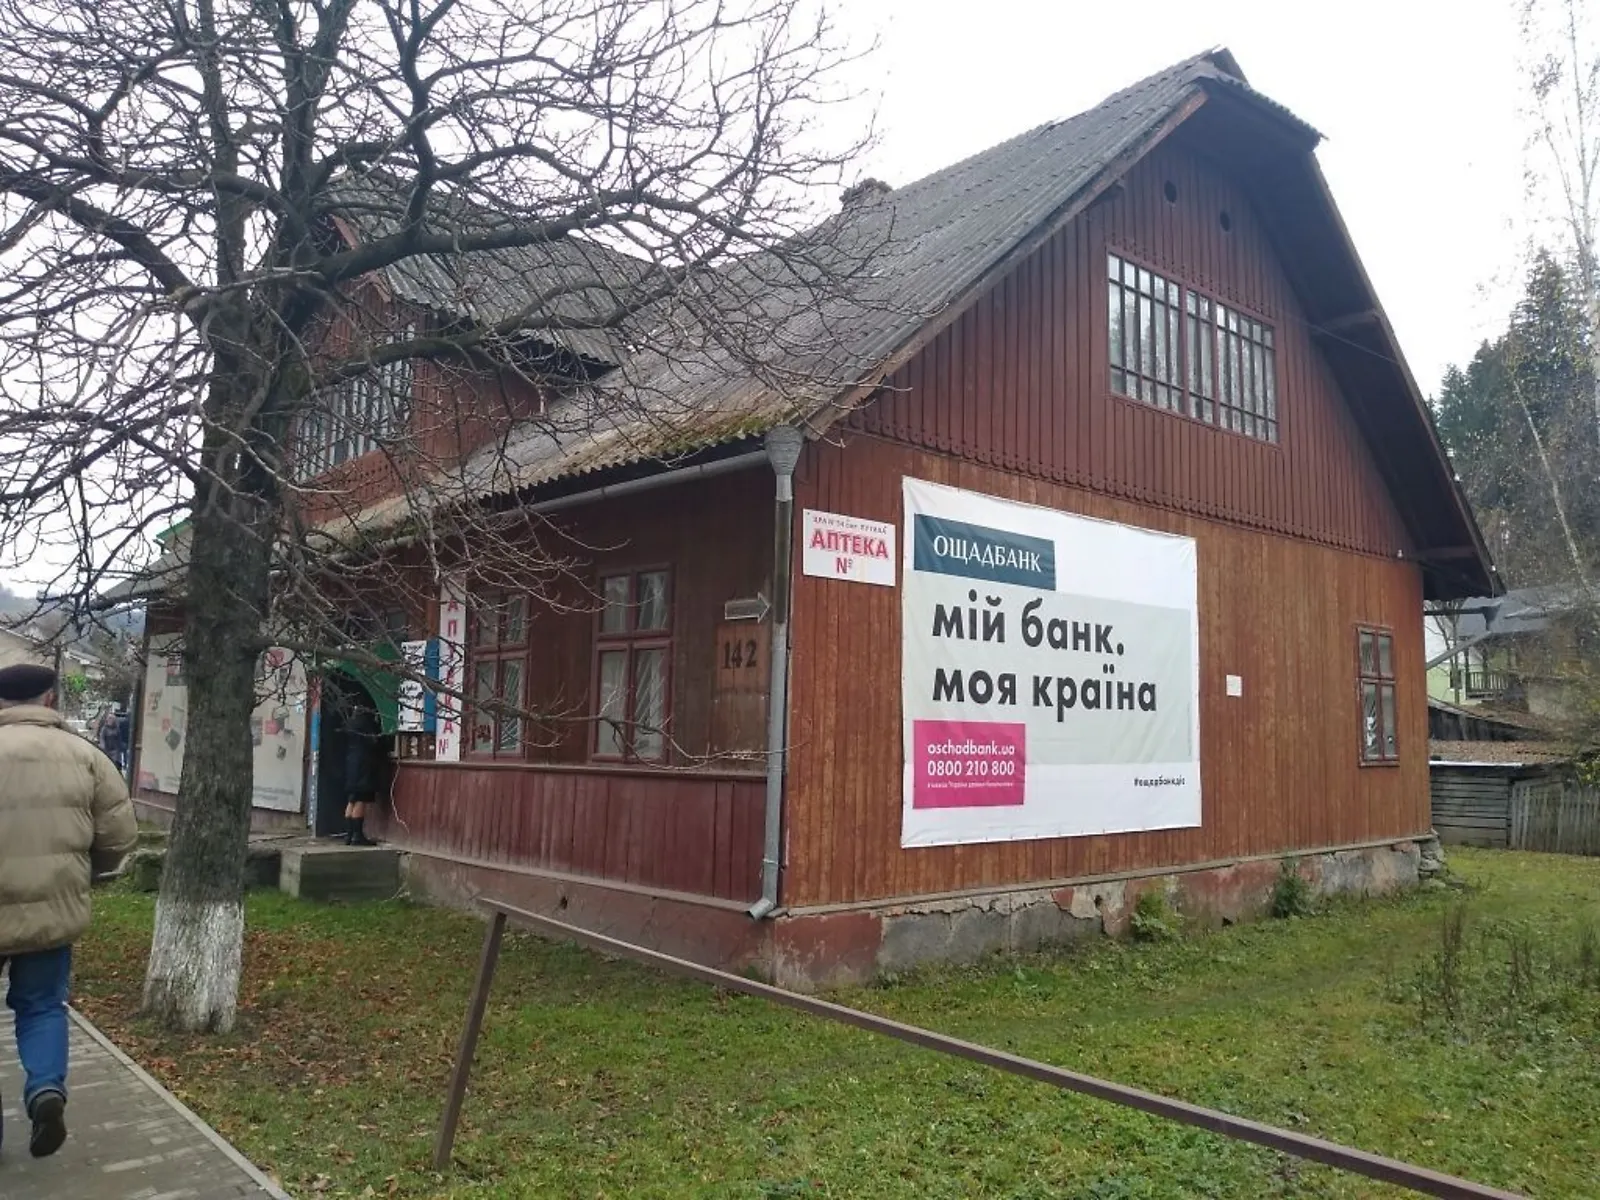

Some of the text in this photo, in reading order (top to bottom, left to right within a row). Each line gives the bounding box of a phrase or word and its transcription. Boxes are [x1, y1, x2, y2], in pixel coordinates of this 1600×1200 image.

[812, 529, 888, 559] АПТЕКА
[933, 535, 1042, 573] ОЩАДБАНК
[932, 588, 1124, 656] мій банк.
[722, 638, 758, 669] 142
[932, 663, 1156, 722] моя країна
[927, 738, 1015, 756] oschadbank.ua
[927, 760, 1015, 776] 0800 210 800
